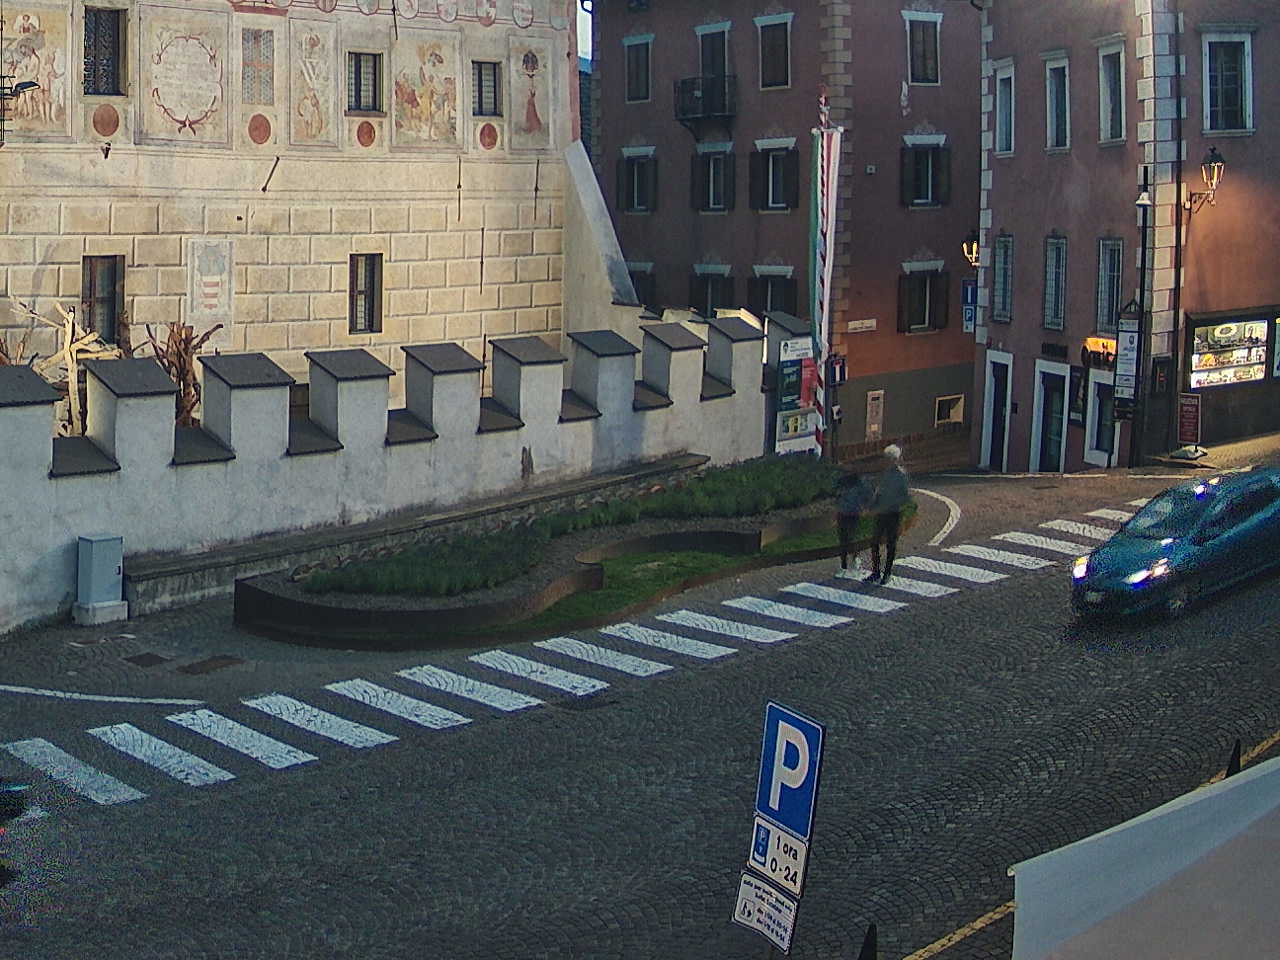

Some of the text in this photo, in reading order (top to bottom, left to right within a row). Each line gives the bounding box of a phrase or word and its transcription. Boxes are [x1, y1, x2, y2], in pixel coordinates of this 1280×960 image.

[769, 720, 809, 811] P
[776, 835, 798, 860] 1 ora
